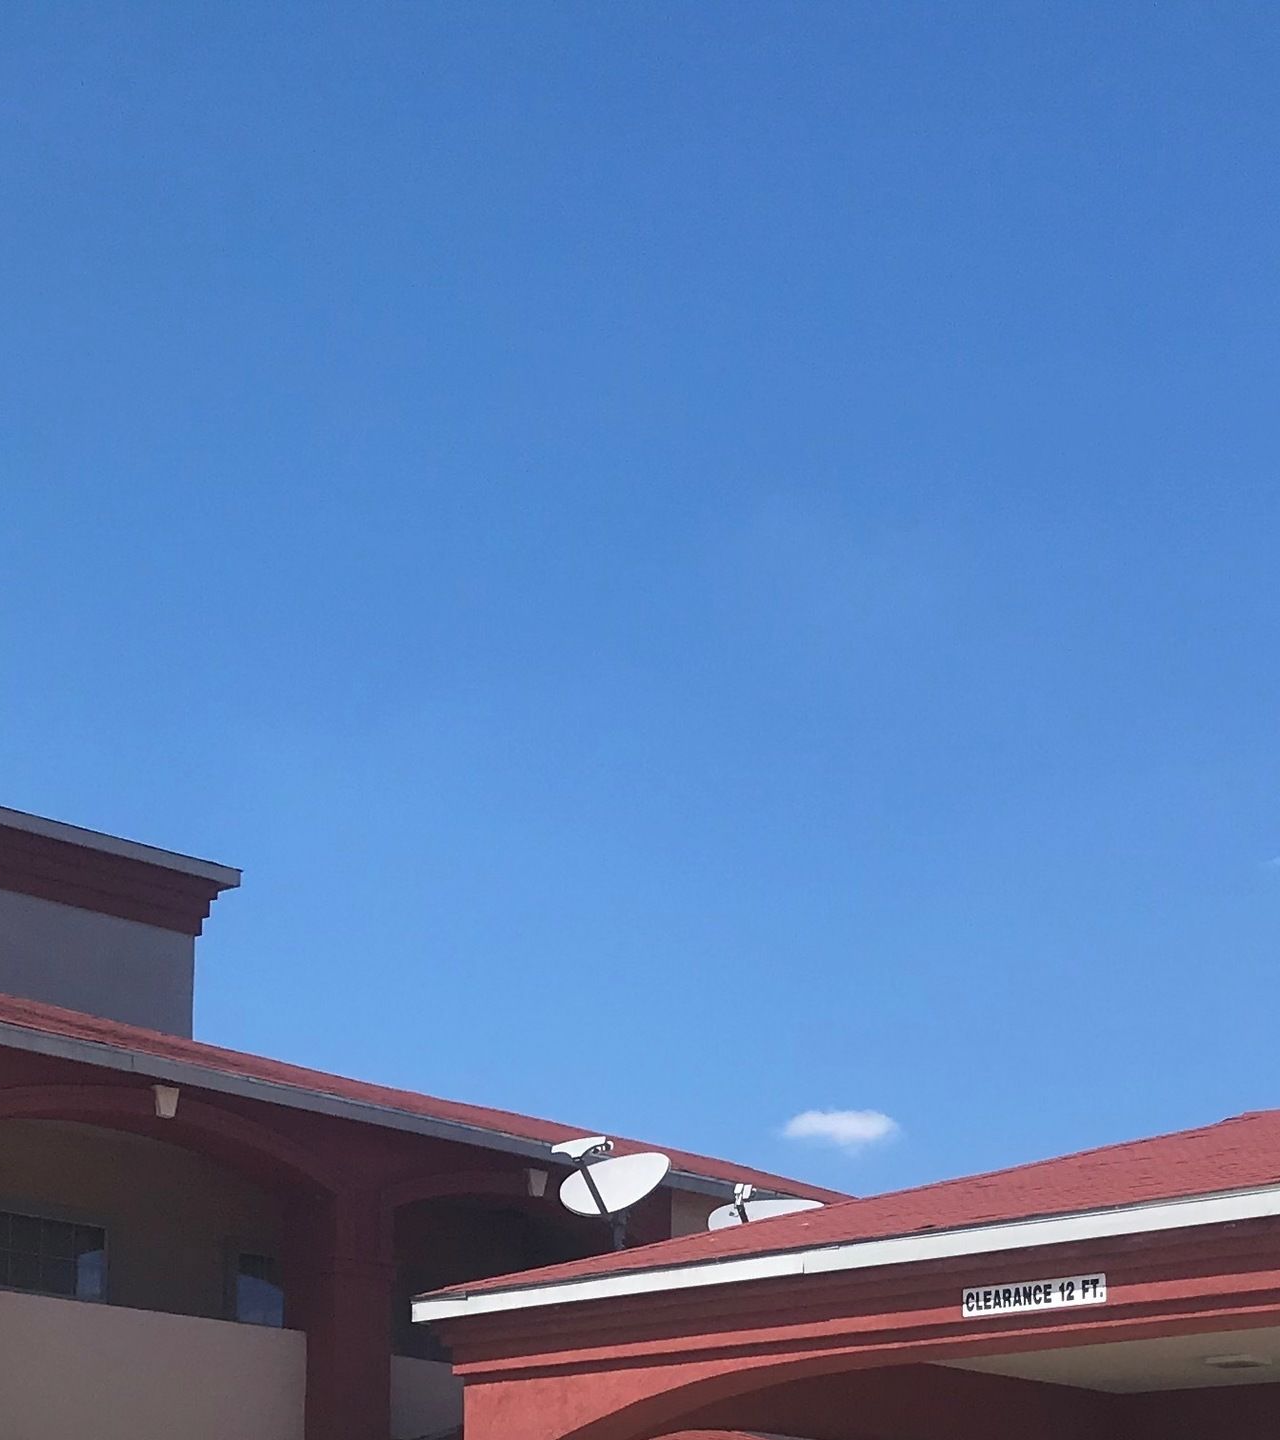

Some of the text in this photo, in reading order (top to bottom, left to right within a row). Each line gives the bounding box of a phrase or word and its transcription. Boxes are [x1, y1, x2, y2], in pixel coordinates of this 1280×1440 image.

[965, 1278, 1104, 1312] CLEARANCE 12 FT.
